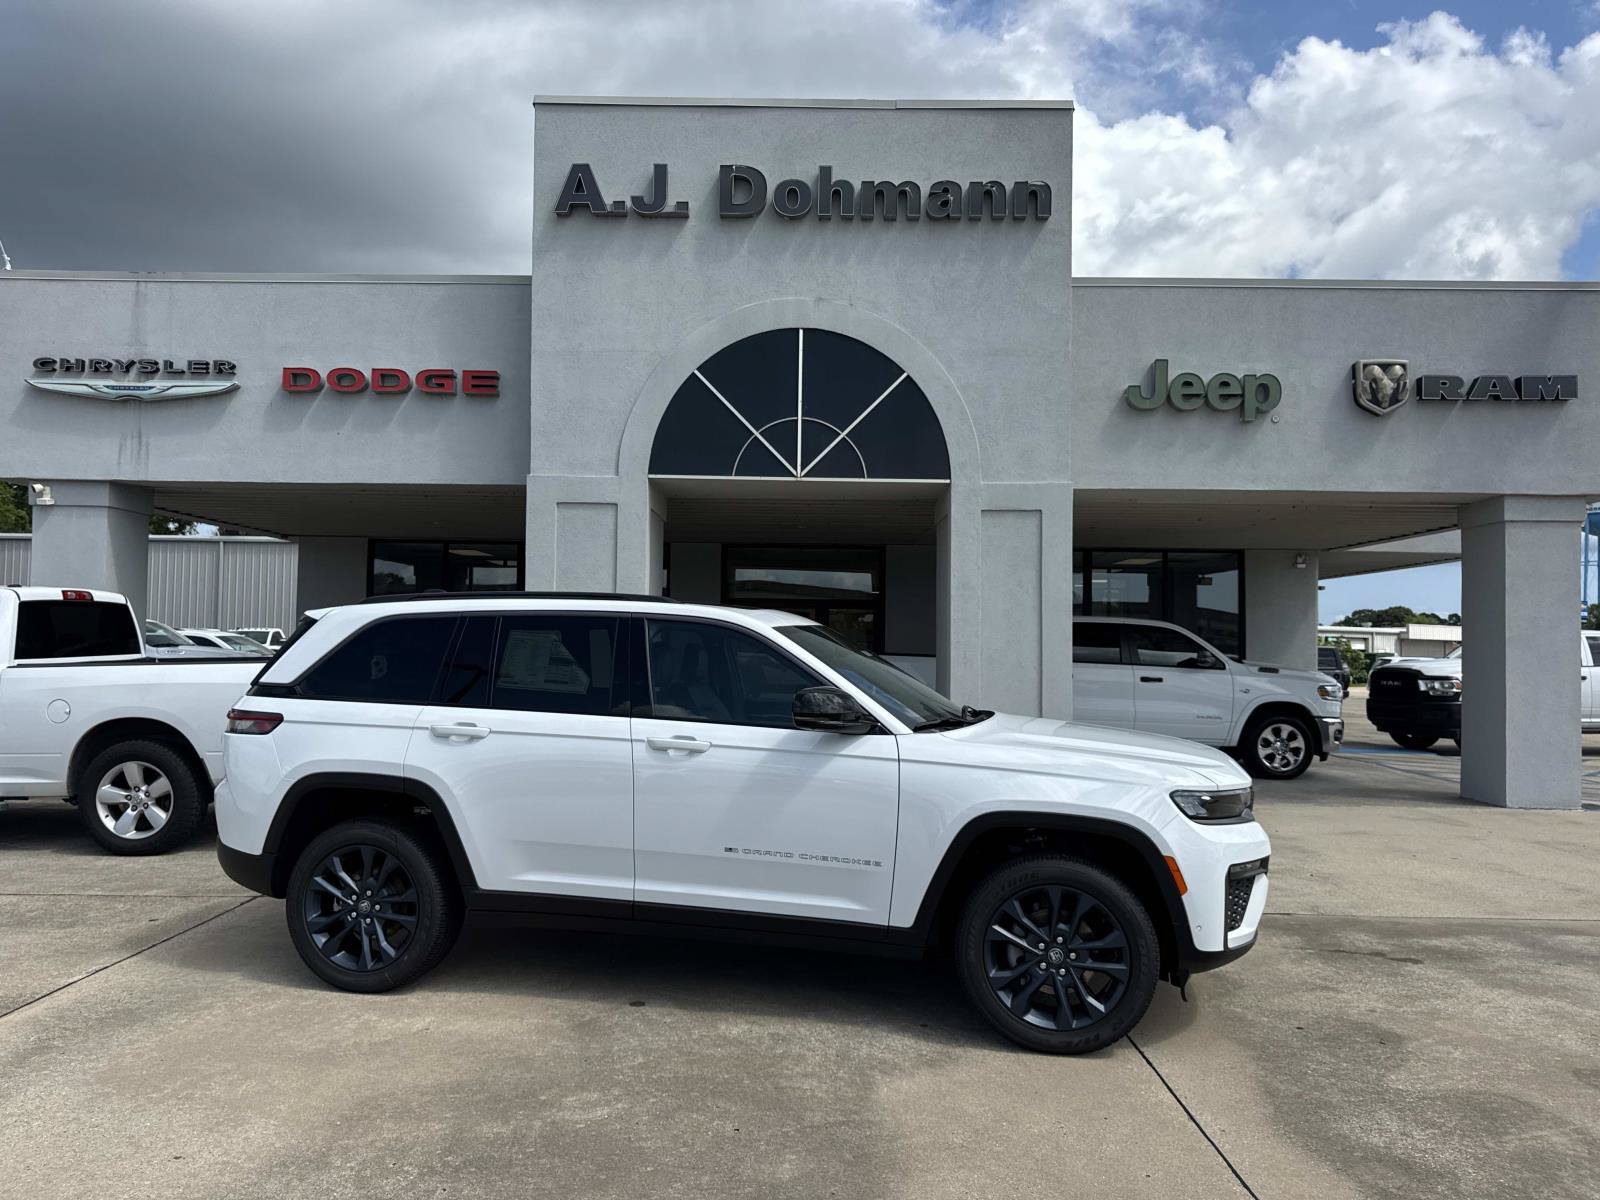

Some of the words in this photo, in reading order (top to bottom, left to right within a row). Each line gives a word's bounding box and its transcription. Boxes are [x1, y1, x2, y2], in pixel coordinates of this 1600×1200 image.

[554, 163, 690, 219] A.J.
[718, 163, 1053, 220] Dohmann
[31, 356, 237, 375] CHRYSLER
[281, 366, 501, 396] DODGE
[1125, 358, 1283, 423] Jeep
[1416, 374, 1579, 401] RAM
[741, 848, 794, 858] GRAND
[798, 853, 882, 867] CHEROKEE
